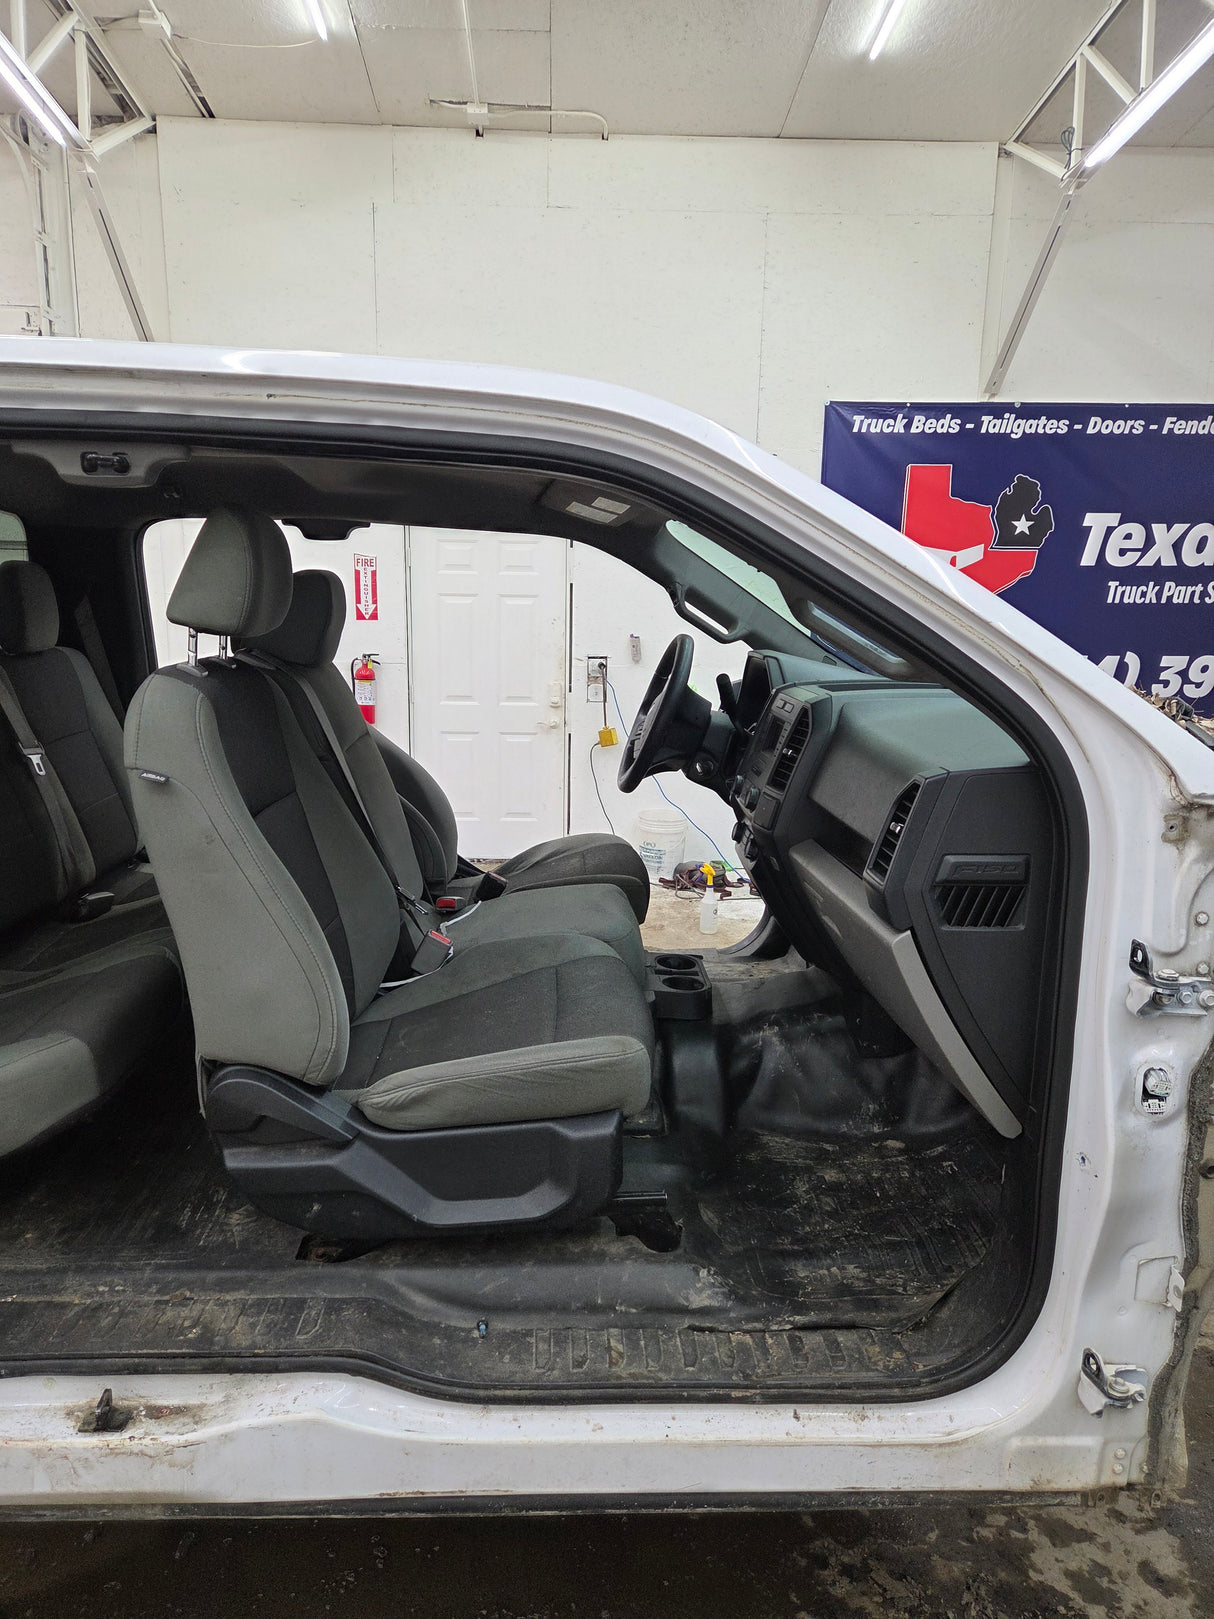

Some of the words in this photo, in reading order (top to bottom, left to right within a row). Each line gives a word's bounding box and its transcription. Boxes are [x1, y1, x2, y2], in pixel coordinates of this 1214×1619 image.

[852, 414, 908, 433] Truck
[910, 414, 962, 433] Beds
[980, 413, 1069, 438] Tailgates
[1086, 416, 1145, 434] Doors
[356, 558, 374, 568] FIRE
[1107, 581, 1160, 604] Truck
[1161, 581, 1203, 604] Part
